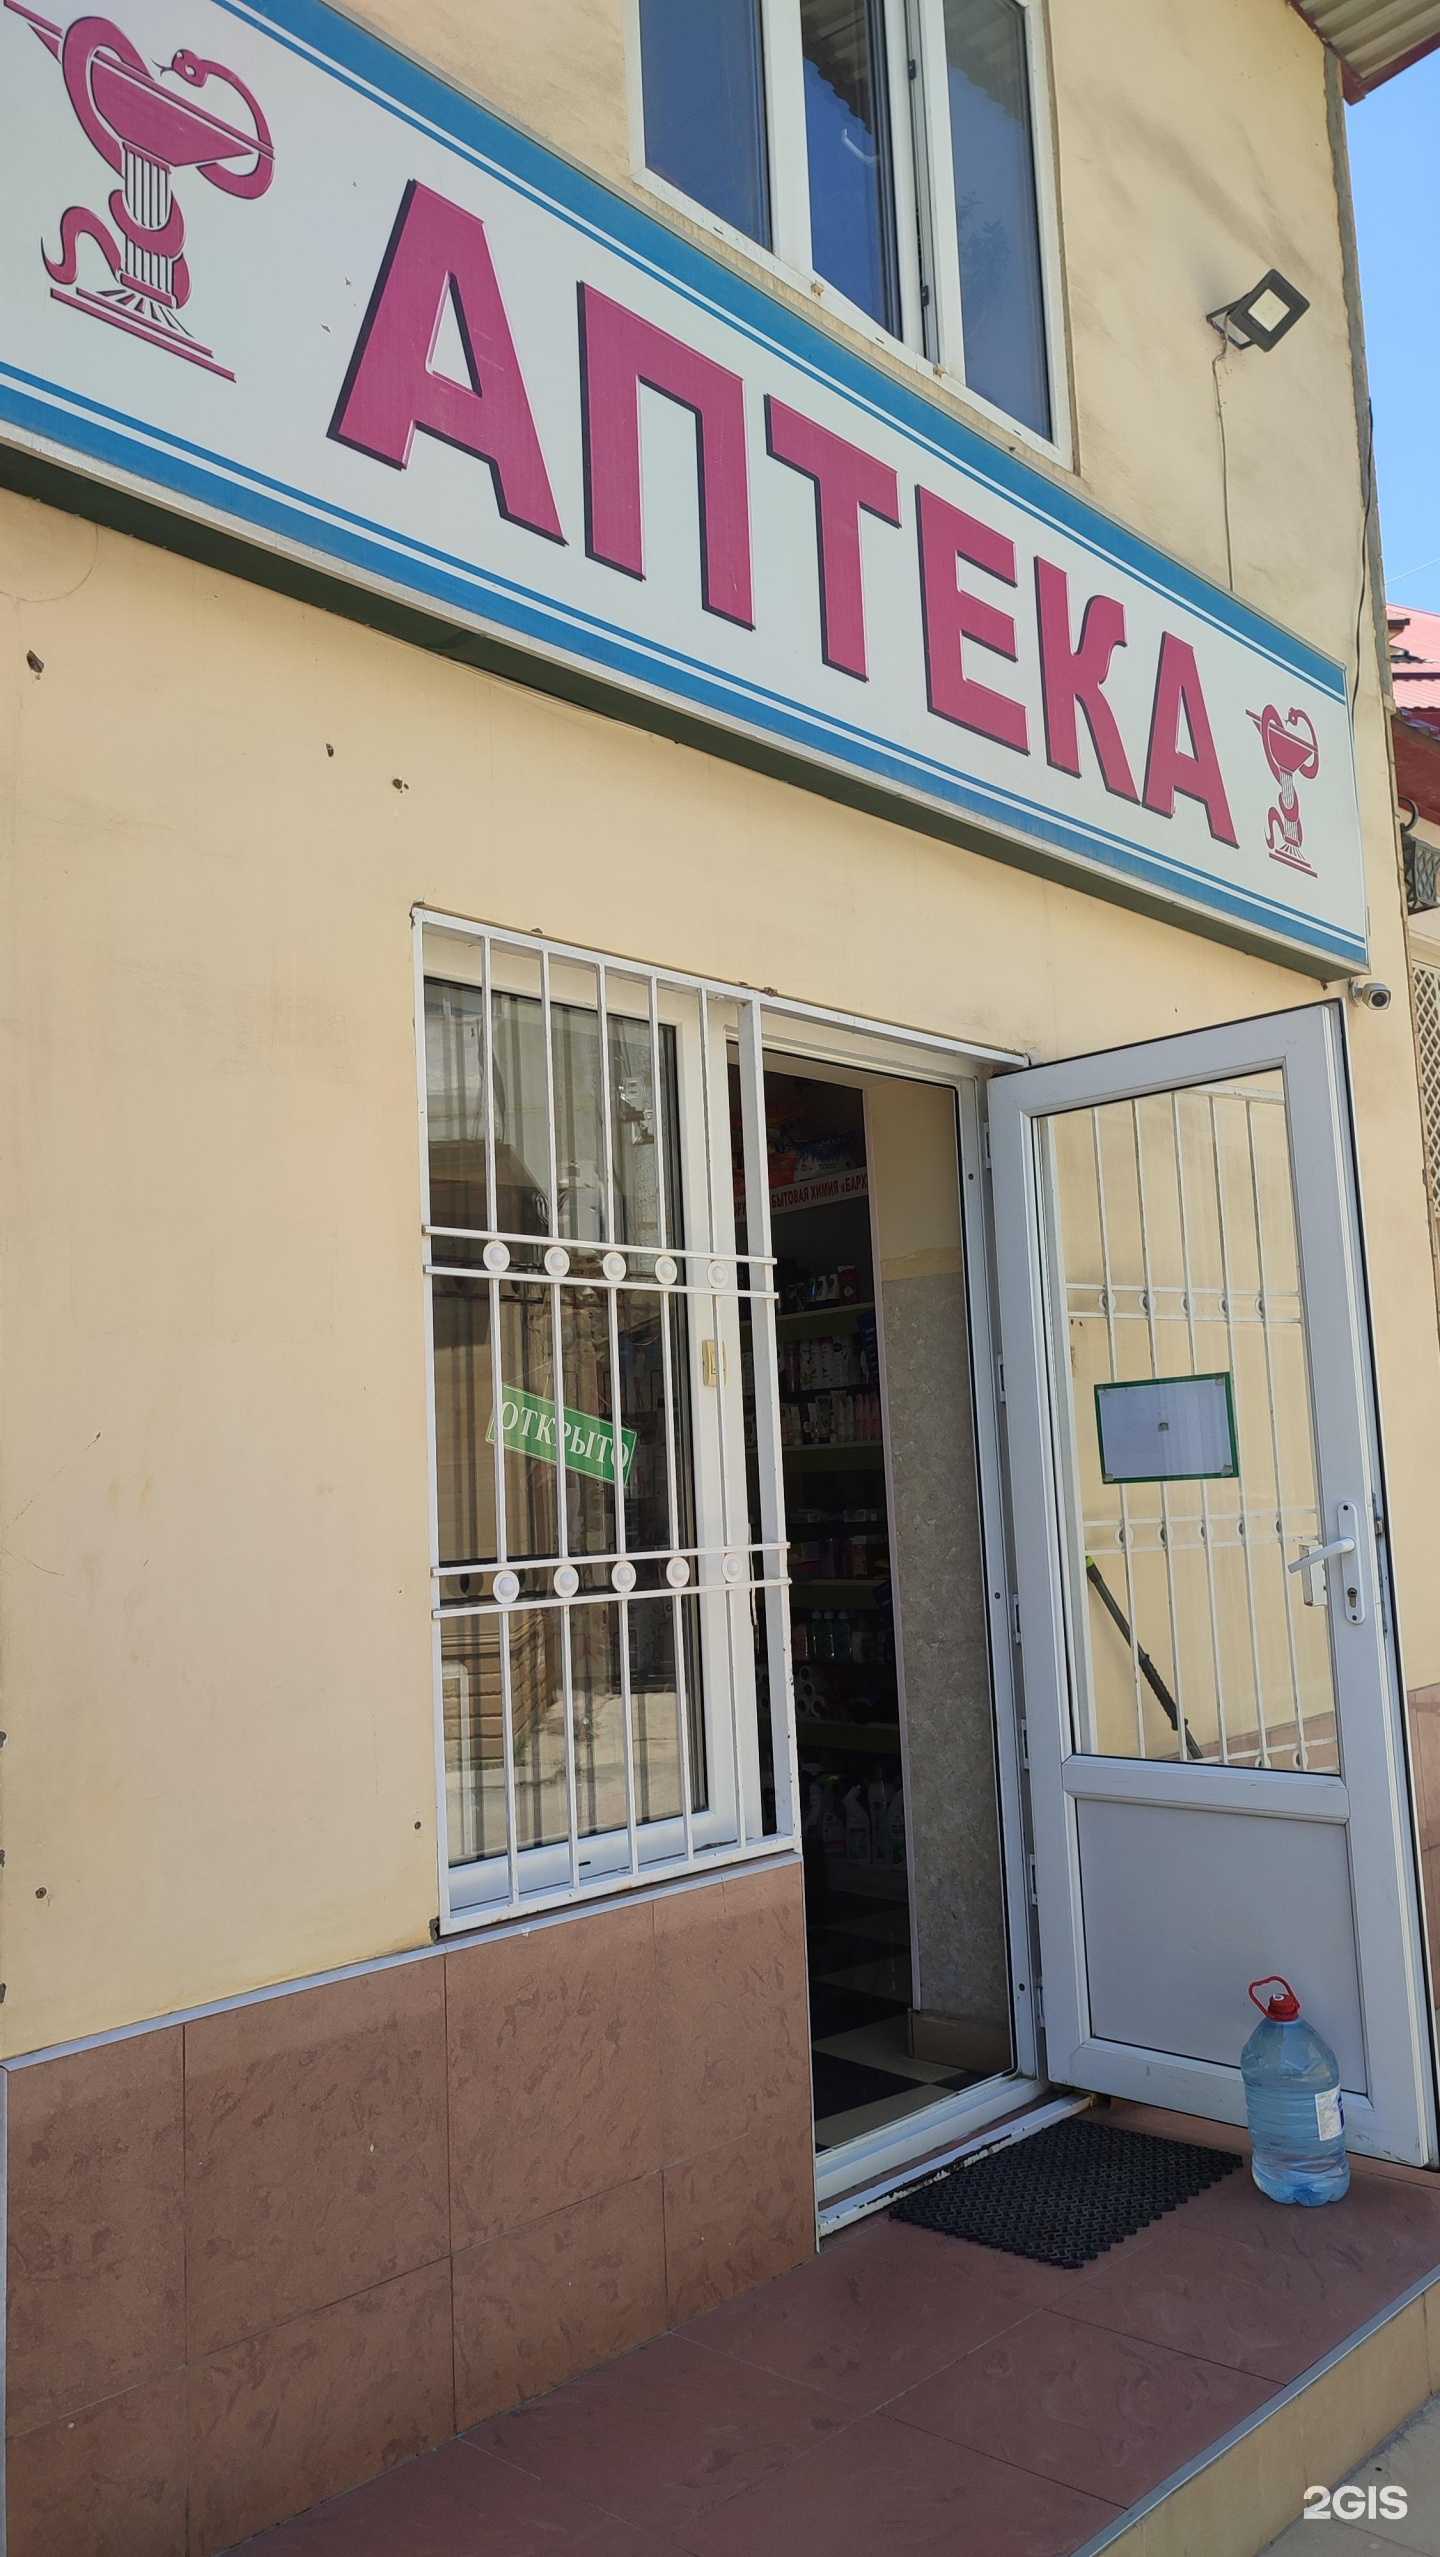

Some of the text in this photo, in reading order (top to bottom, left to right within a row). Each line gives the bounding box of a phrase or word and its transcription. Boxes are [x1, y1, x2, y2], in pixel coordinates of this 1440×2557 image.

[328, 179, 1239, 849] АПТЕКА
[772, 1172, 868, 1208] БЫТОВАЯ ХИМИЯ «БАРХ
[500, 1401, 629, 1468] ОТКРЫТО
